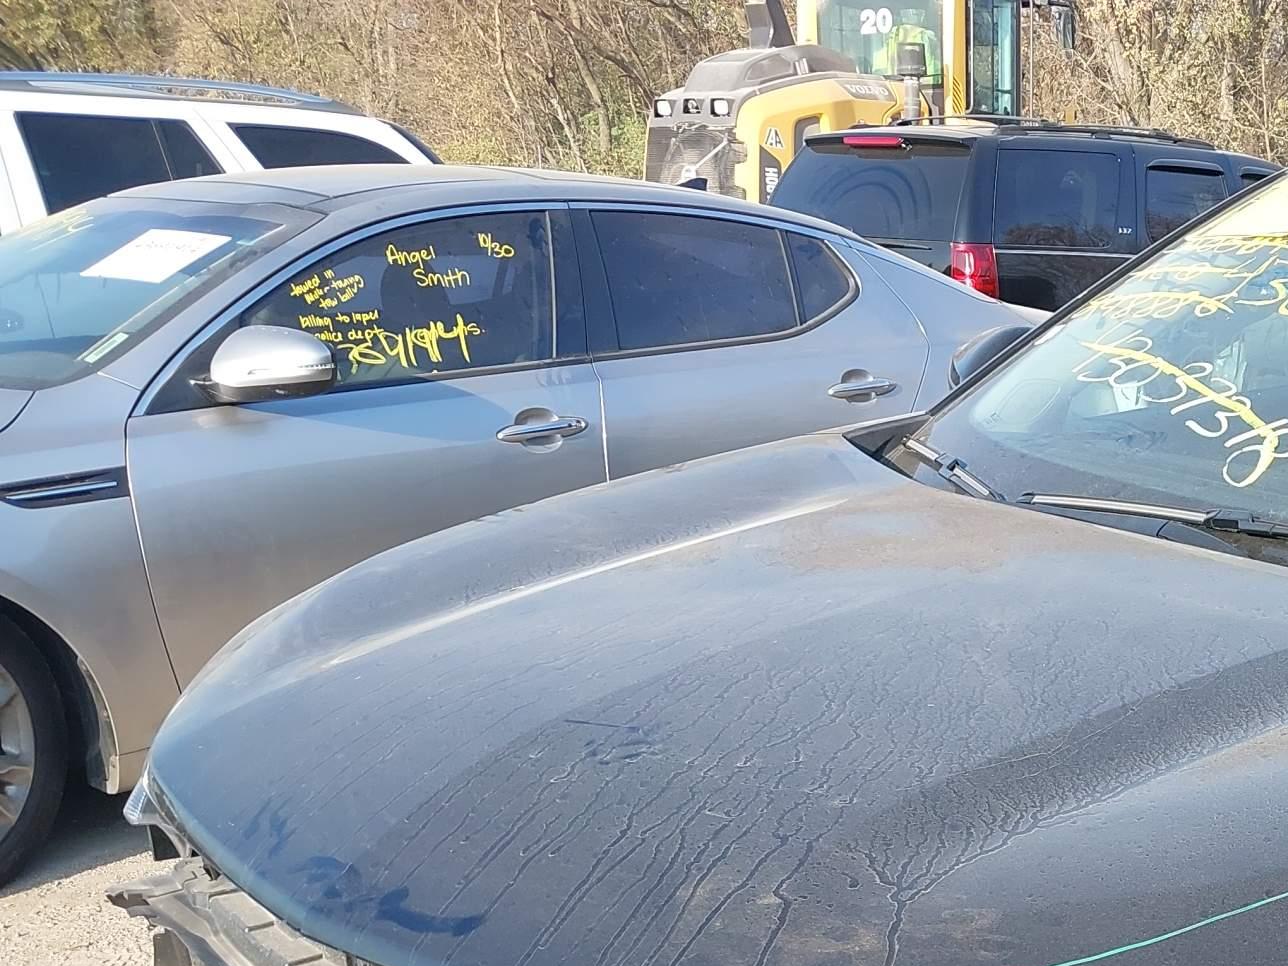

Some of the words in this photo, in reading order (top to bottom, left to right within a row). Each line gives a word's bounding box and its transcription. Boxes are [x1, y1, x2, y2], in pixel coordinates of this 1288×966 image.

[860, 8, 892, 34] 20
[845, 84, 889, 96] VOLVO
[386, 244, 436, 269] Angel
[478, 232, 515, 258] 10/30
[290, 274, 321, 297] towed
[413, 268, 471, 289] Smith
[336, 313, 350, 324] to
